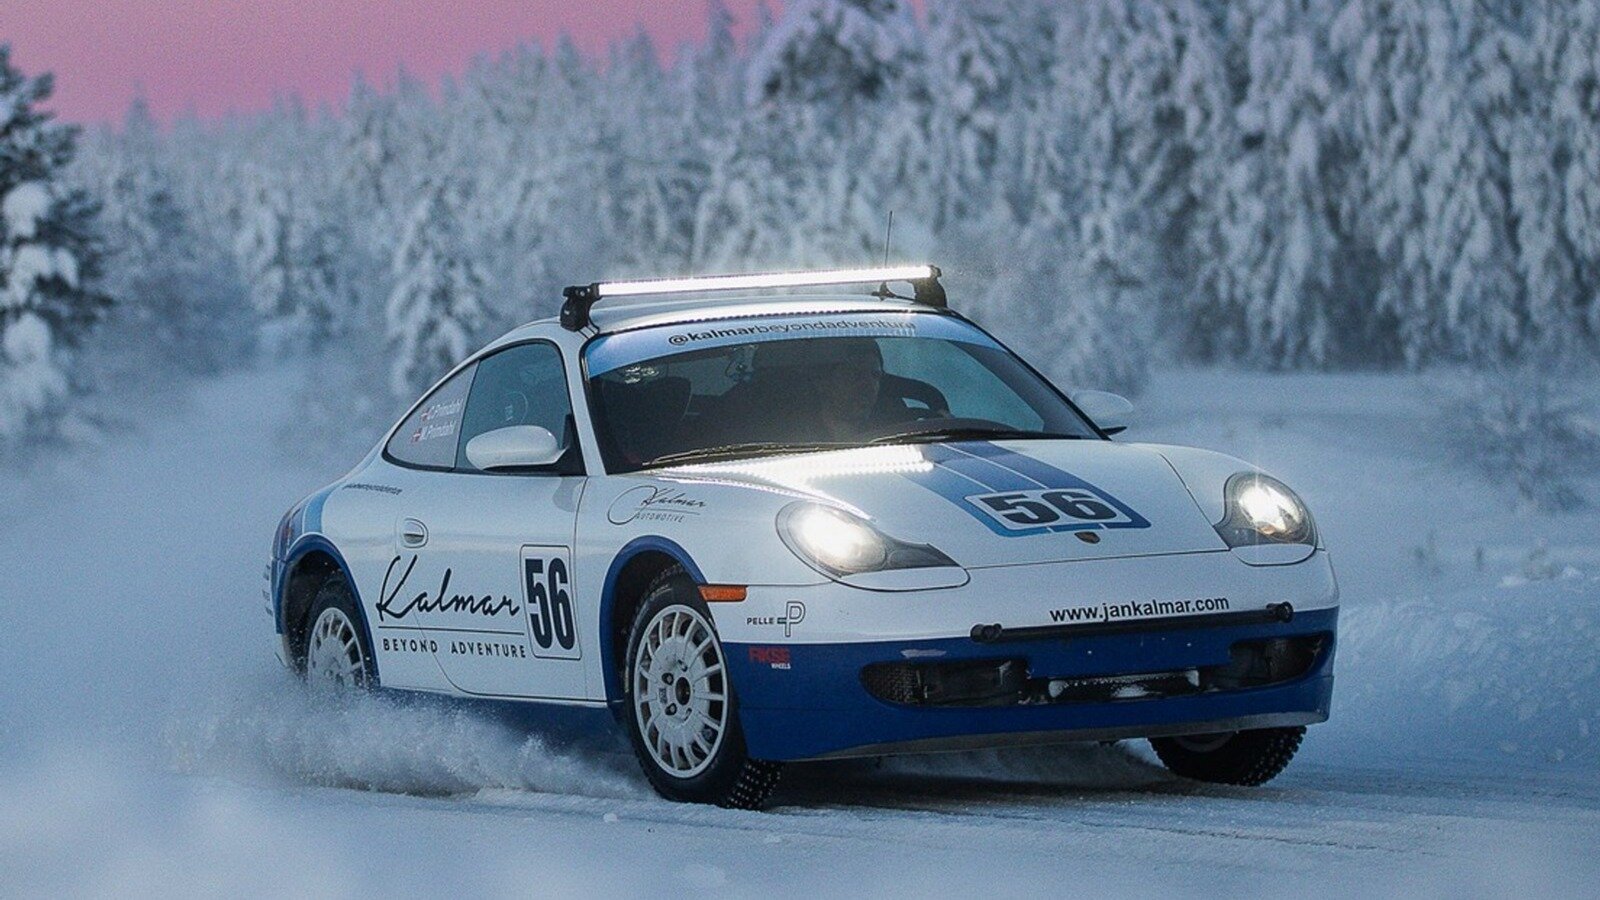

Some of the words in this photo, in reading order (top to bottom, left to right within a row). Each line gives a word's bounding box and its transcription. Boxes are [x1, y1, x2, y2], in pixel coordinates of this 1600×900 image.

[668, 319, 916, 346] @kalmarbeyondadventure
[635, 512, 685, 523] AUTOMOTIVE
[980, 491, 1117, 525] 56
[376, 554, 520, 622] Kalmar
[525, 557, 575, 650] 56
[1050, 597, 1230, 622] www.jankalmar.com
[746, 617, 775, 625] PELLE
[382, 638, 438, 654] BEYOND
[451, 641, 526, 658] ADVENTURE
